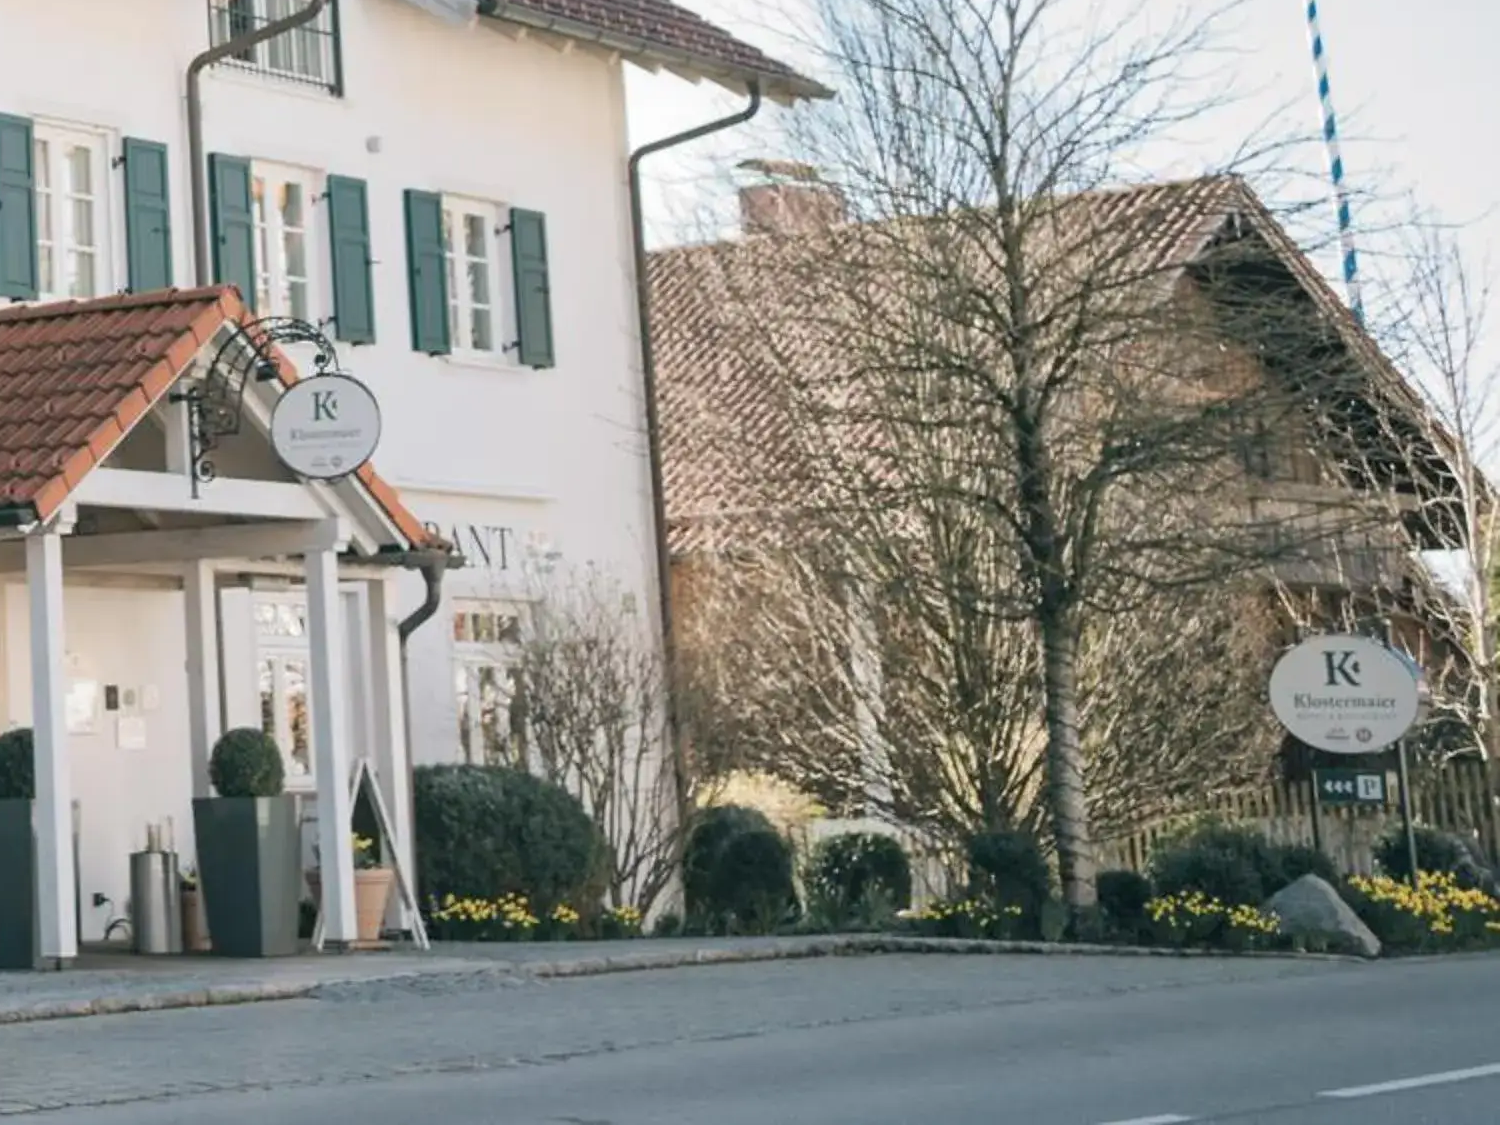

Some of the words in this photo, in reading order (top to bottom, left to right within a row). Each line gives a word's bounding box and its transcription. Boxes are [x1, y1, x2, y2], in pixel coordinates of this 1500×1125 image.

[311, 390, 338, 422] K
[1322, 650, 1361, 687] K
[1293, 693, 1397, 710] Klostermaier
[1363, 778, 1378, 796] P
